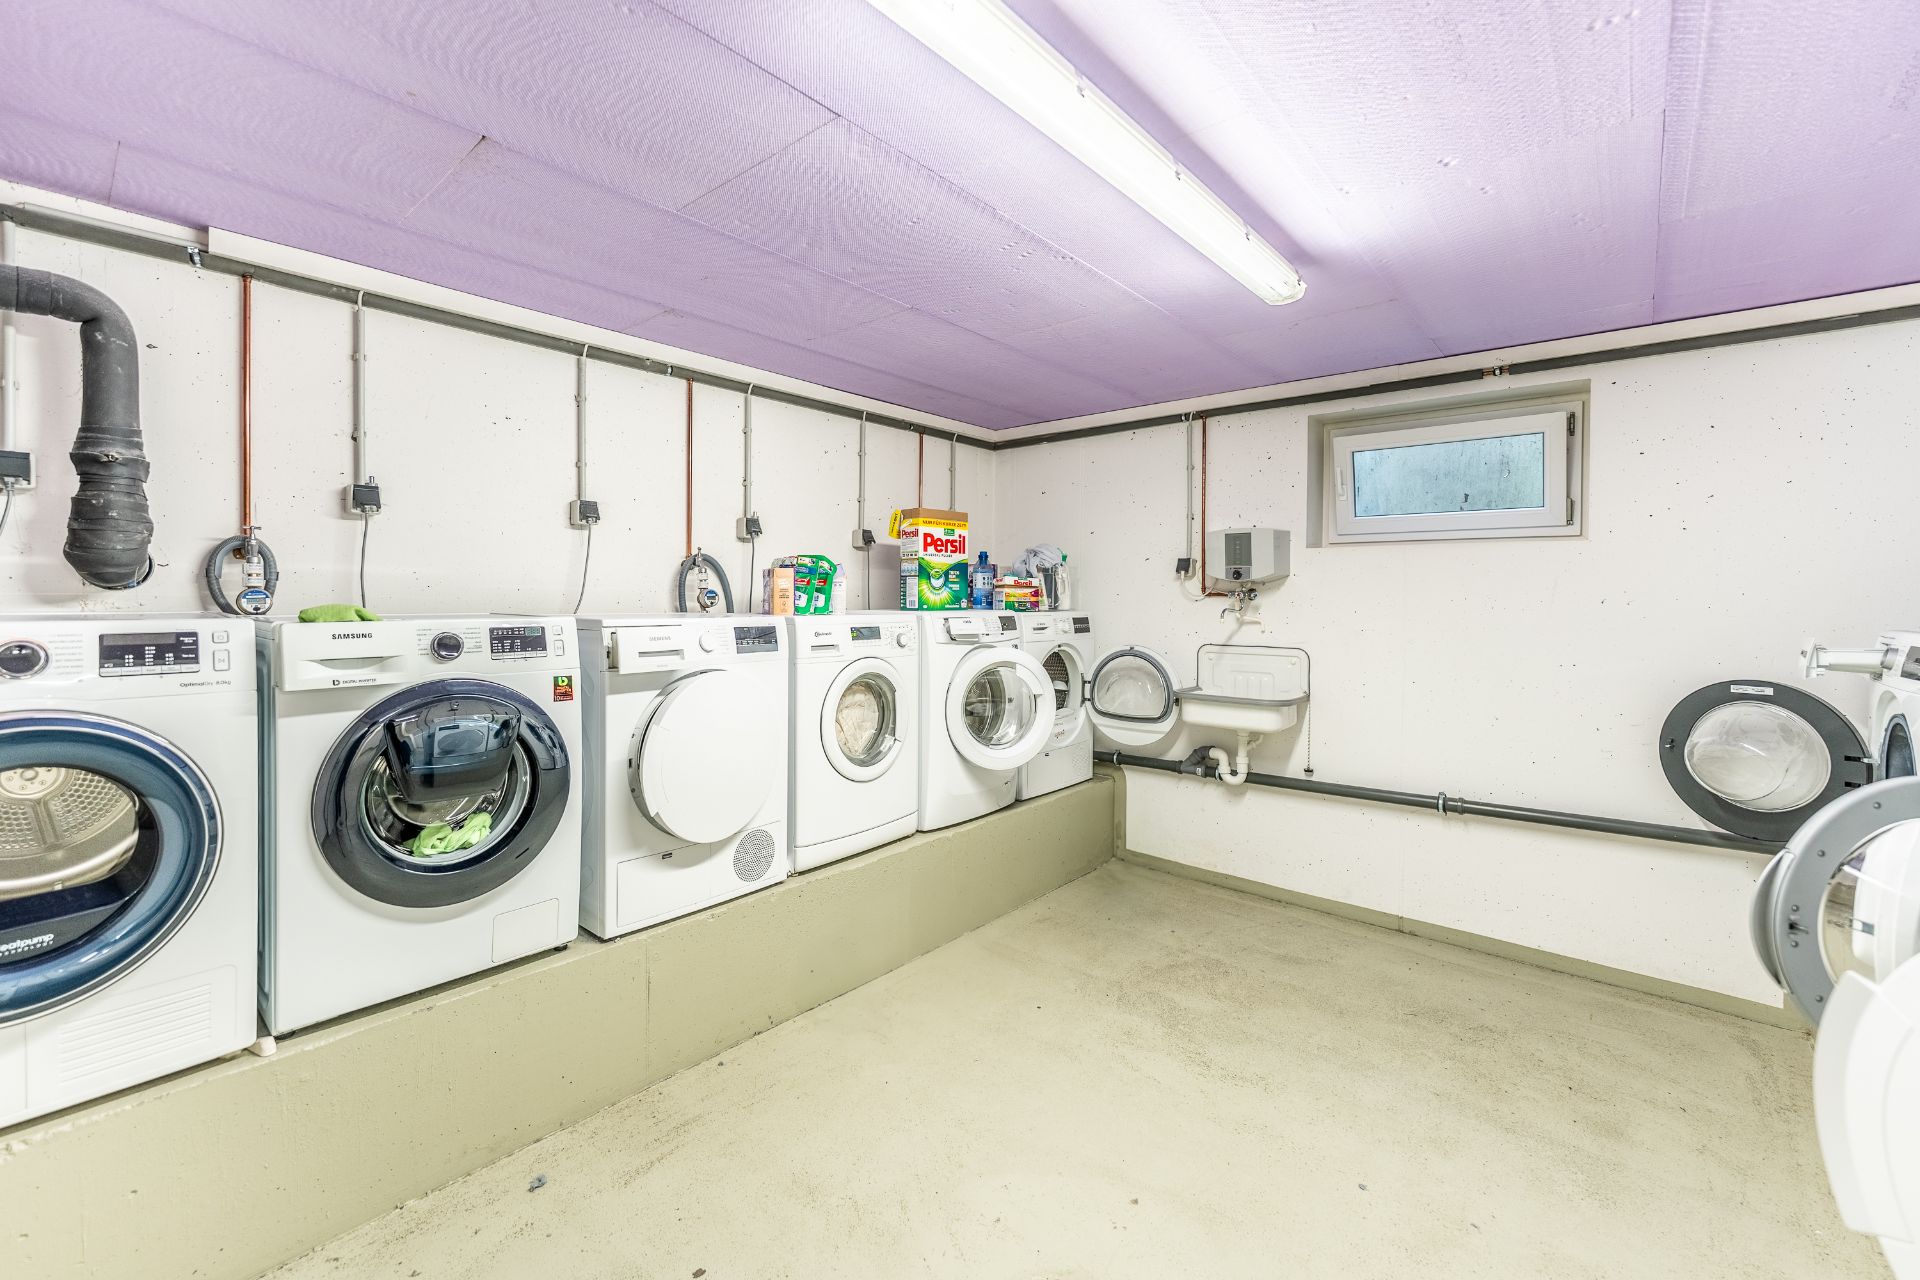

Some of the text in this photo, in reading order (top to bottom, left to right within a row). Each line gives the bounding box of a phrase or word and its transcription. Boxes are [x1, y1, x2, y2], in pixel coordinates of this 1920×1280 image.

[901, 528, 919, 538] Persil
[923, 533, 966, 555] Persil
[331, 632, 373, 640] SAMSUNG
